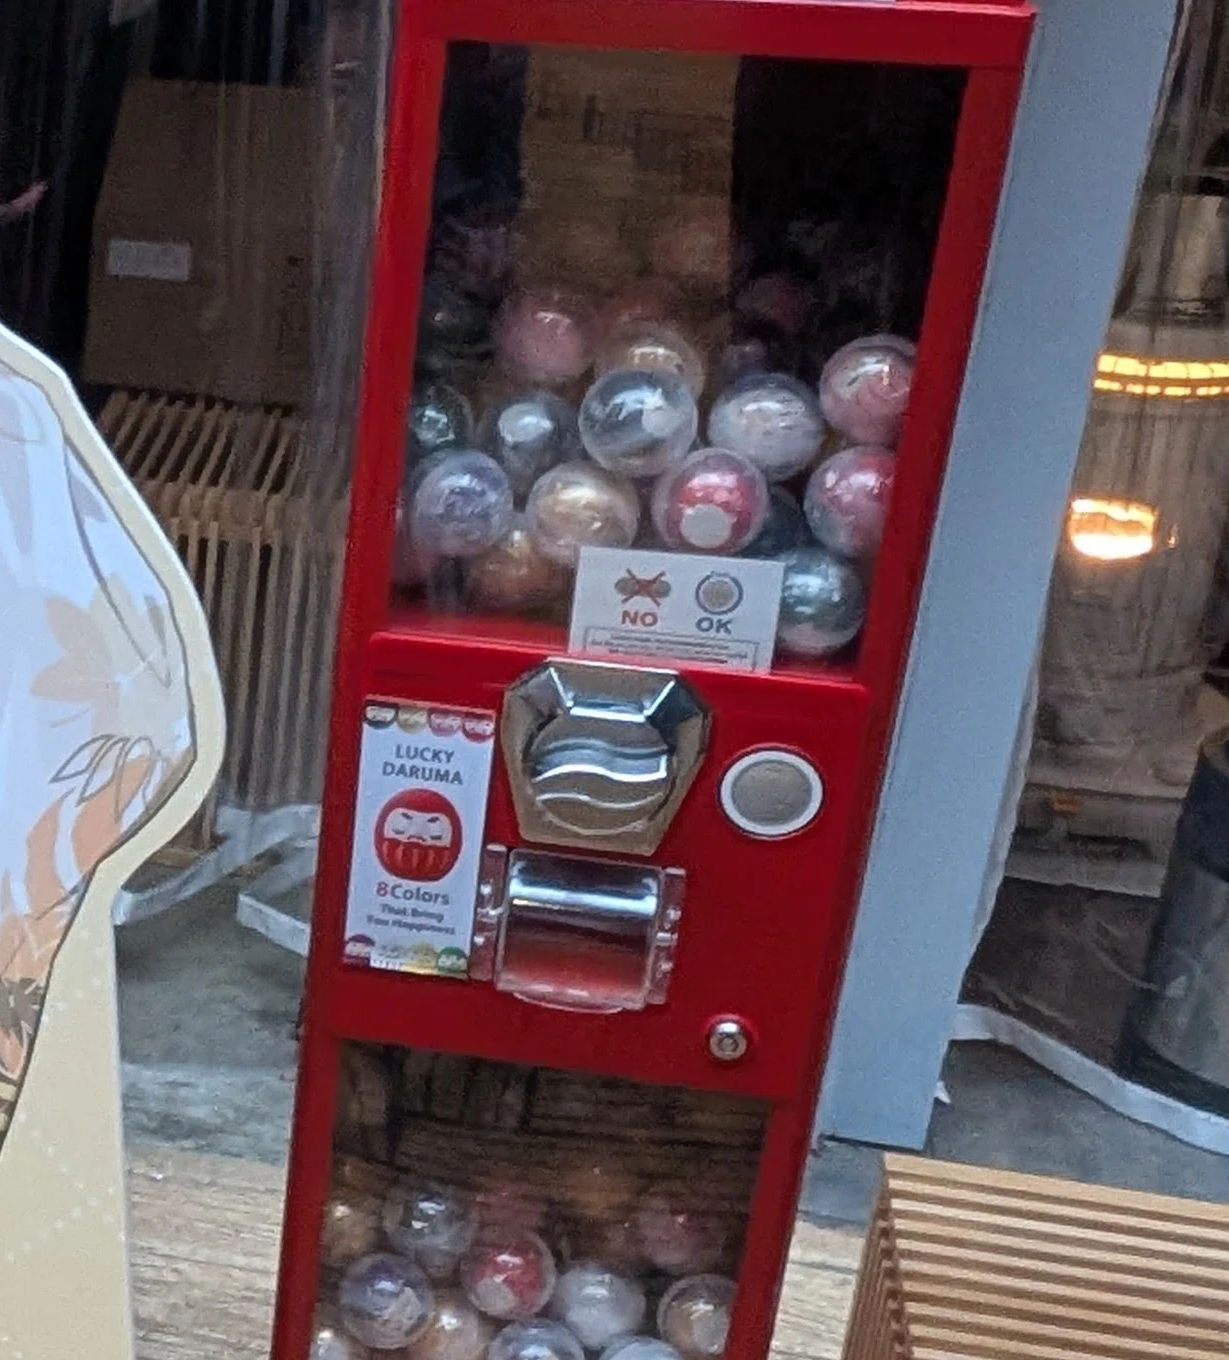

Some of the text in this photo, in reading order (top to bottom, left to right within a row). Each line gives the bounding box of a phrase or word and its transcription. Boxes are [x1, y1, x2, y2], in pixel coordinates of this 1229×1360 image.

[621, 610, 733, 635] NO OK
[395, 744, 455, 765] LUCKY
[382, 761, 464, 786] DARUMA
